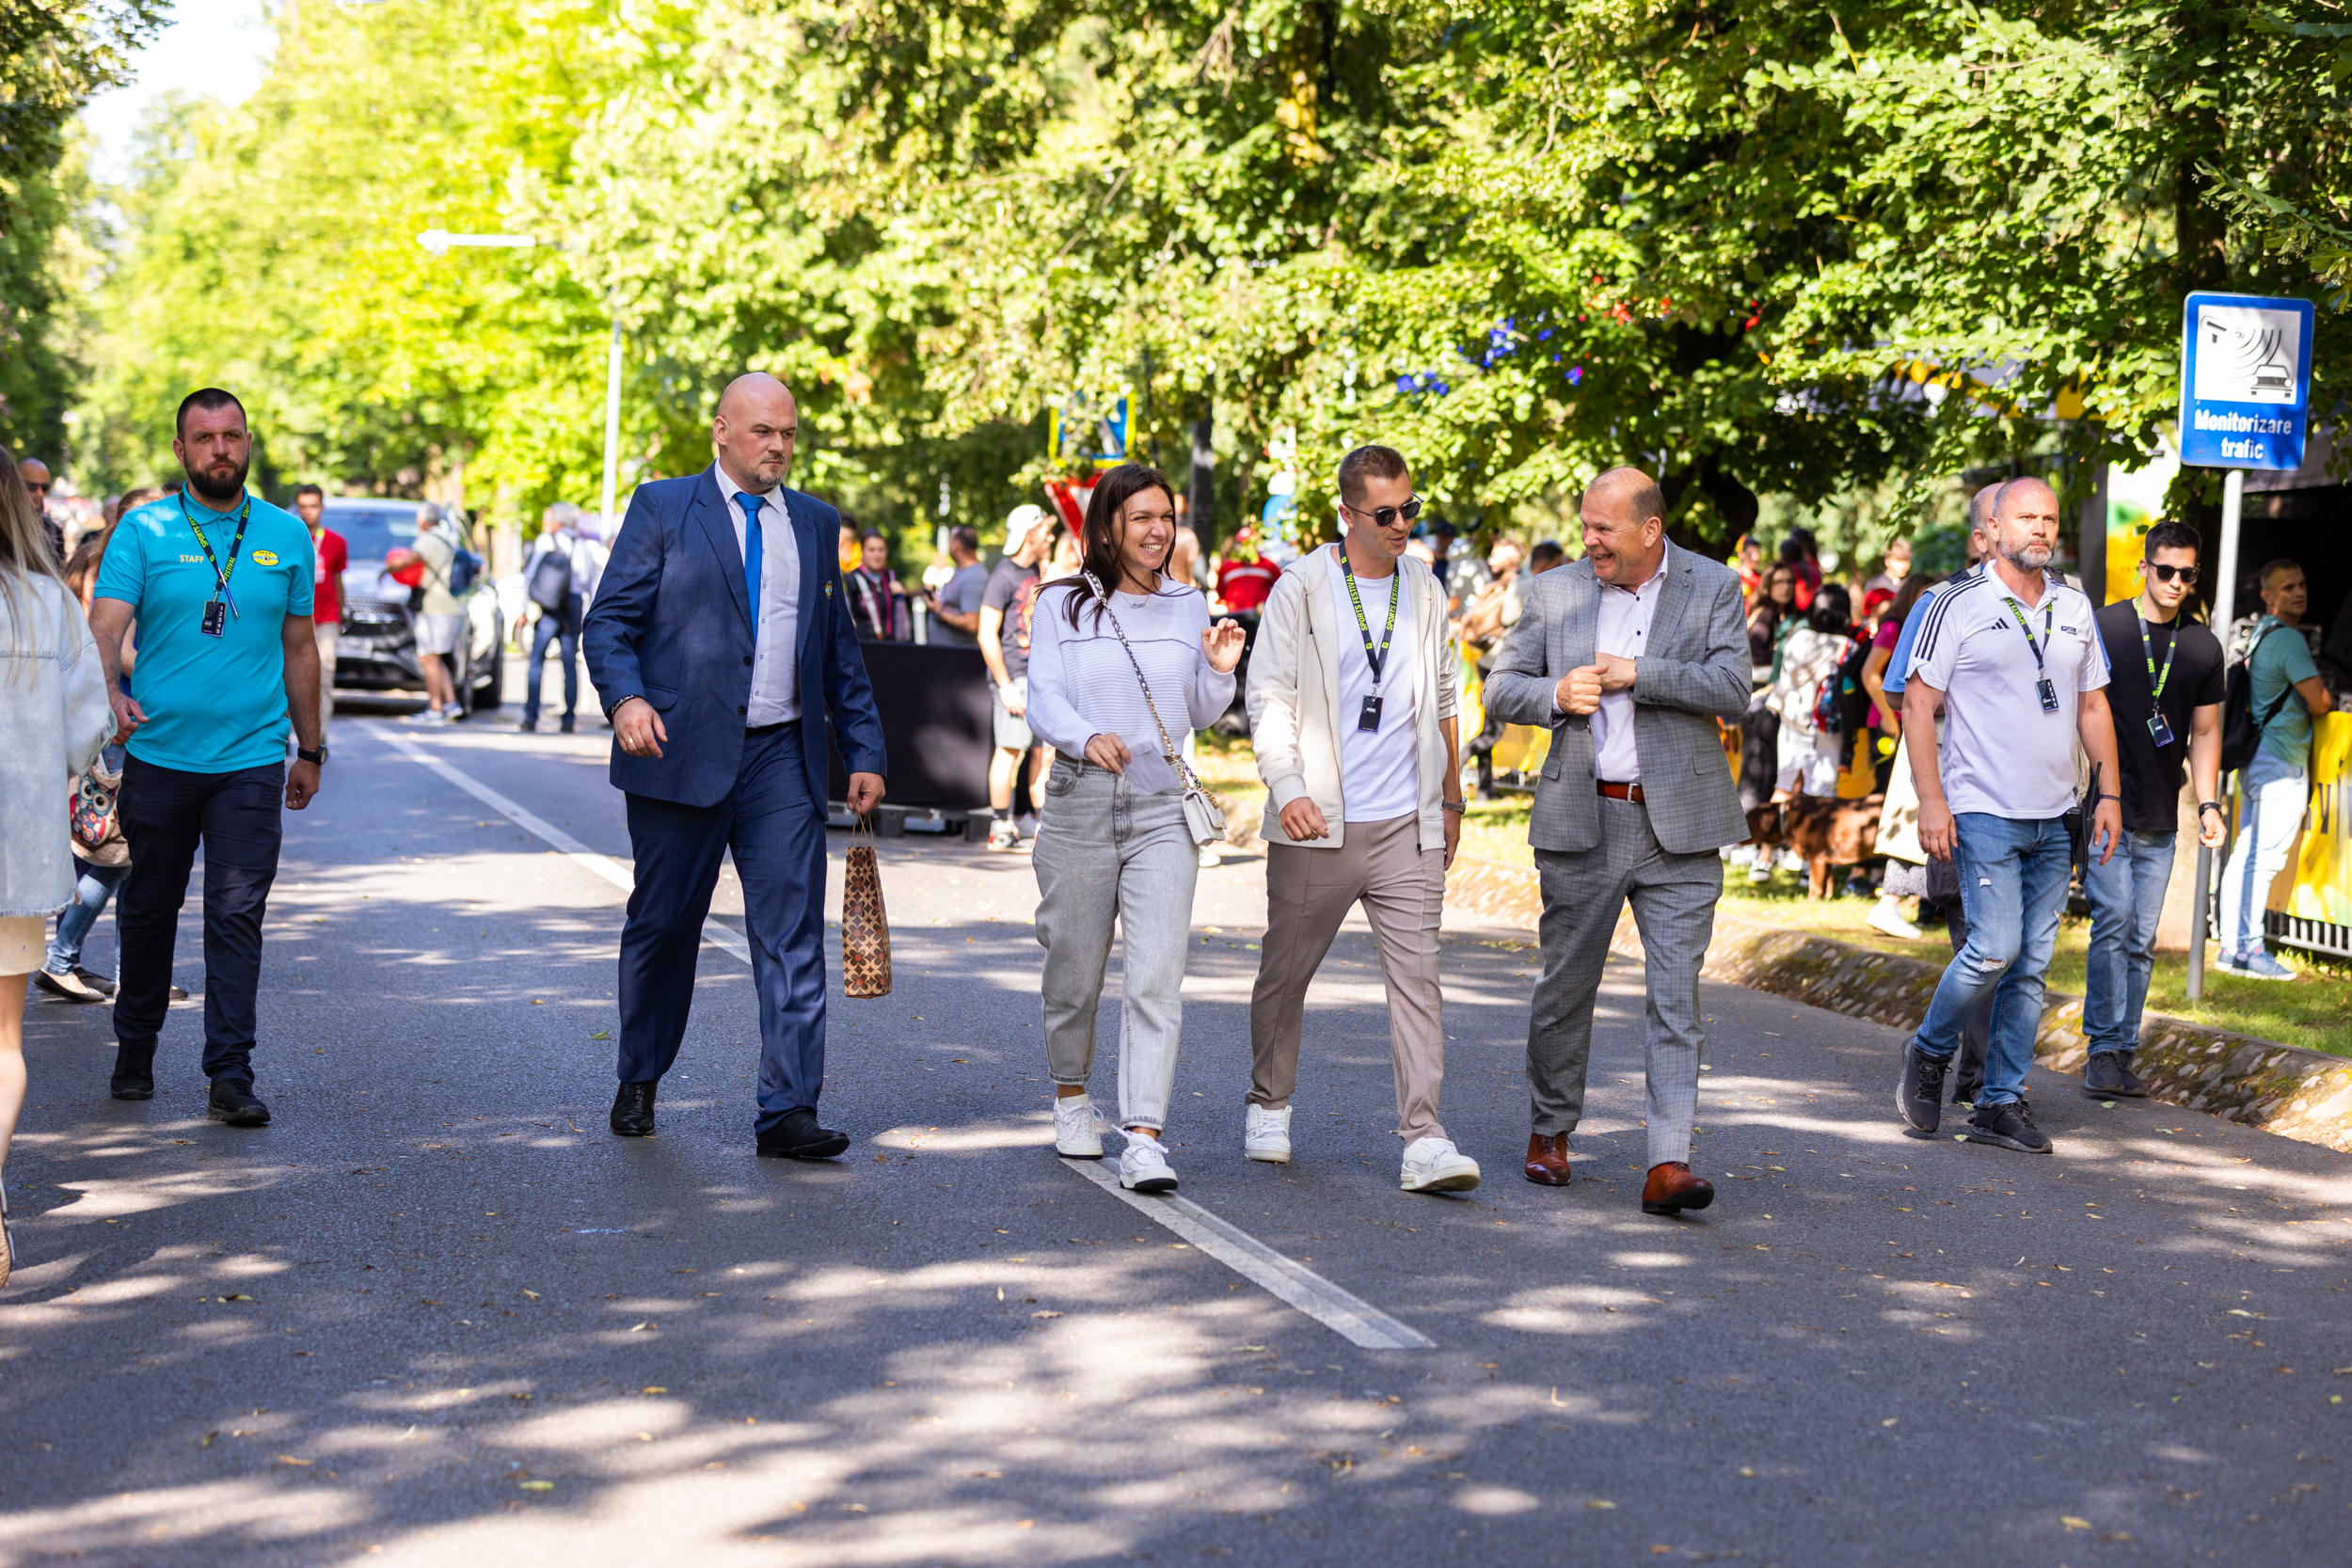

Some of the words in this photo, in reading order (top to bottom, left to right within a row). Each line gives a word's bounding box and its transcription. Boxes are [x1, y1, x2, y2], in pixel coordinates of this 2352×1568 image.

[2194, 408, 2293, 435] Monitorizare
[2221, 436, 2264, 460] trafic
[180, 554, 205, 563] STAFF
[1345, 573, 1360, 605] FESTIVAL
[1391, 575, 1399, 605] FESTIVAL
[1355, 604, 1368, 631] SPORTS
[1386, 605, 1397, 631] SPORTS
